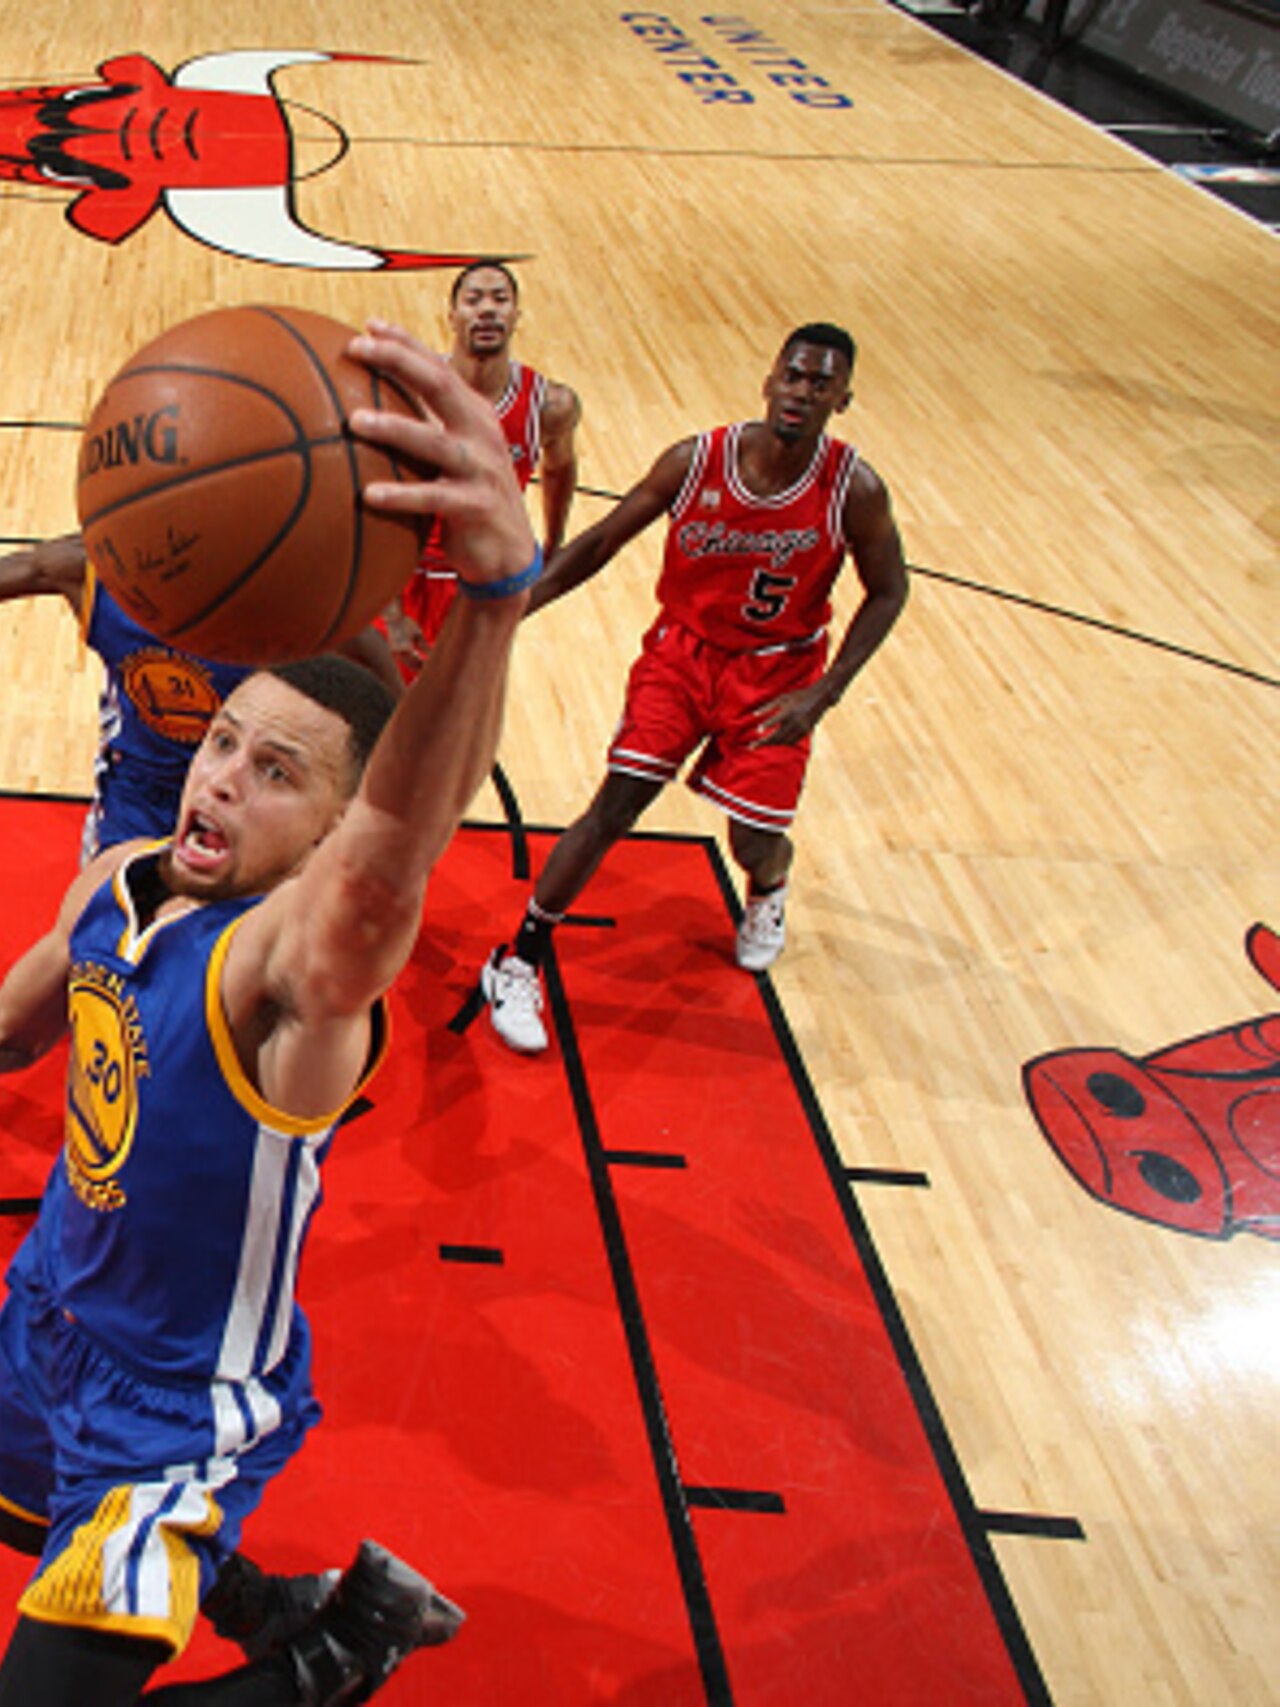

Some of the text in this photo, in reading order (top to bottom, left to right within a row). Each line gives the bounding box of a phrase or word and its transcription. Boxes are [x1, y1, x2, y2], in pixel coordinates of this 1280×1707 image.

[620, 12, 755, 104] CENTER
[700, 15, 854, 108] UNITED
[679, 520, 819, 569] Chicago
[741, 567, 797, 625] 5
[85, 1038, 122, 1105] 30
